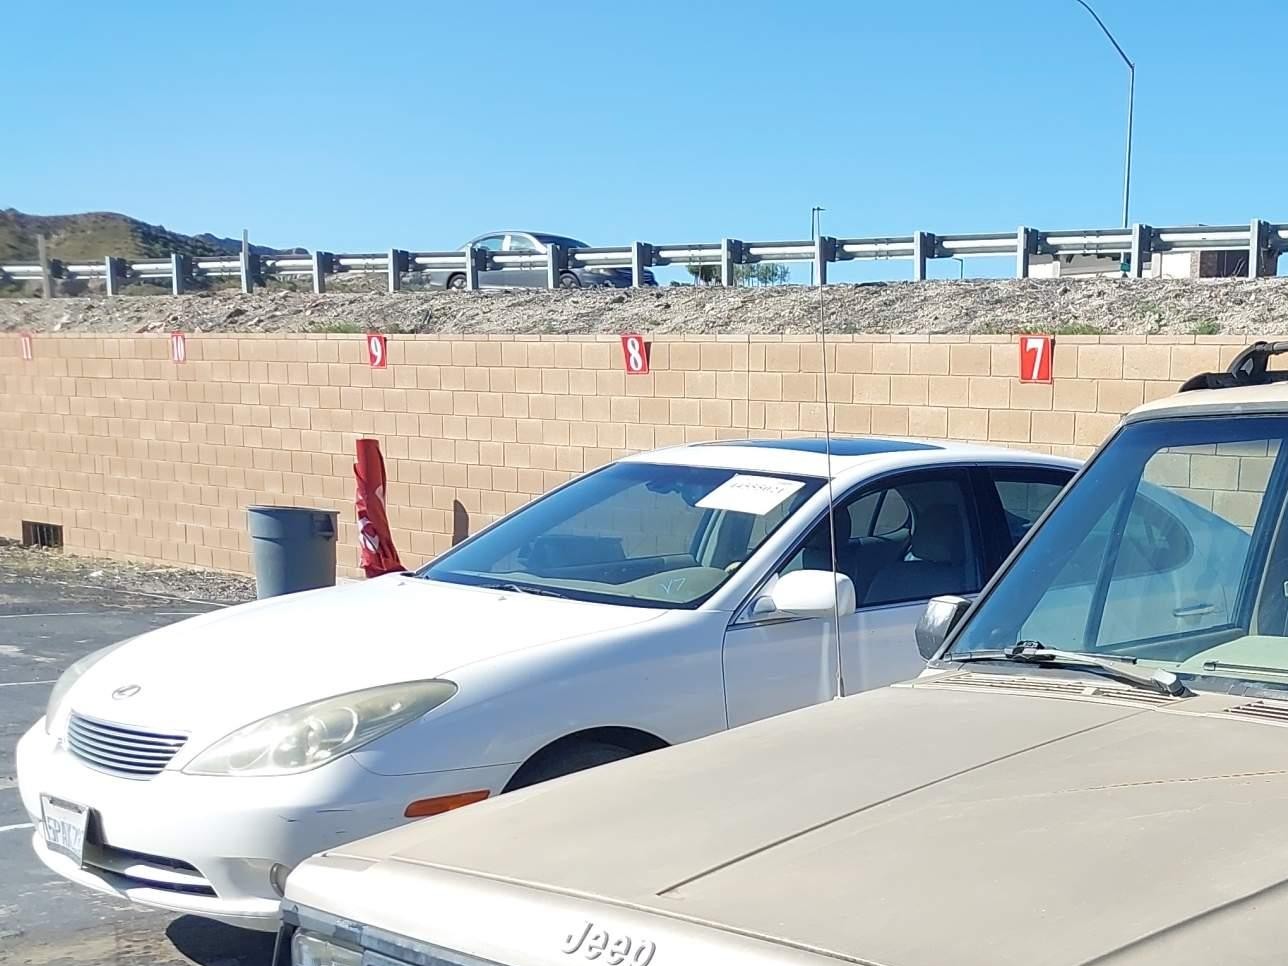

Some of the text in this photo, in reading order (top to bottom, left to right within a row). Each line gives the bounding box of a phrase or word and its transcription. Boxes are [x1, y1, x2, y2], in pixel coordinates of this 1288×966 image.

[171, 335, 187, 362] 10
[369, 336, 384, 367] 9
[626, 336, 645, 372] 8
[1025, 337, 1045, 380] 7
